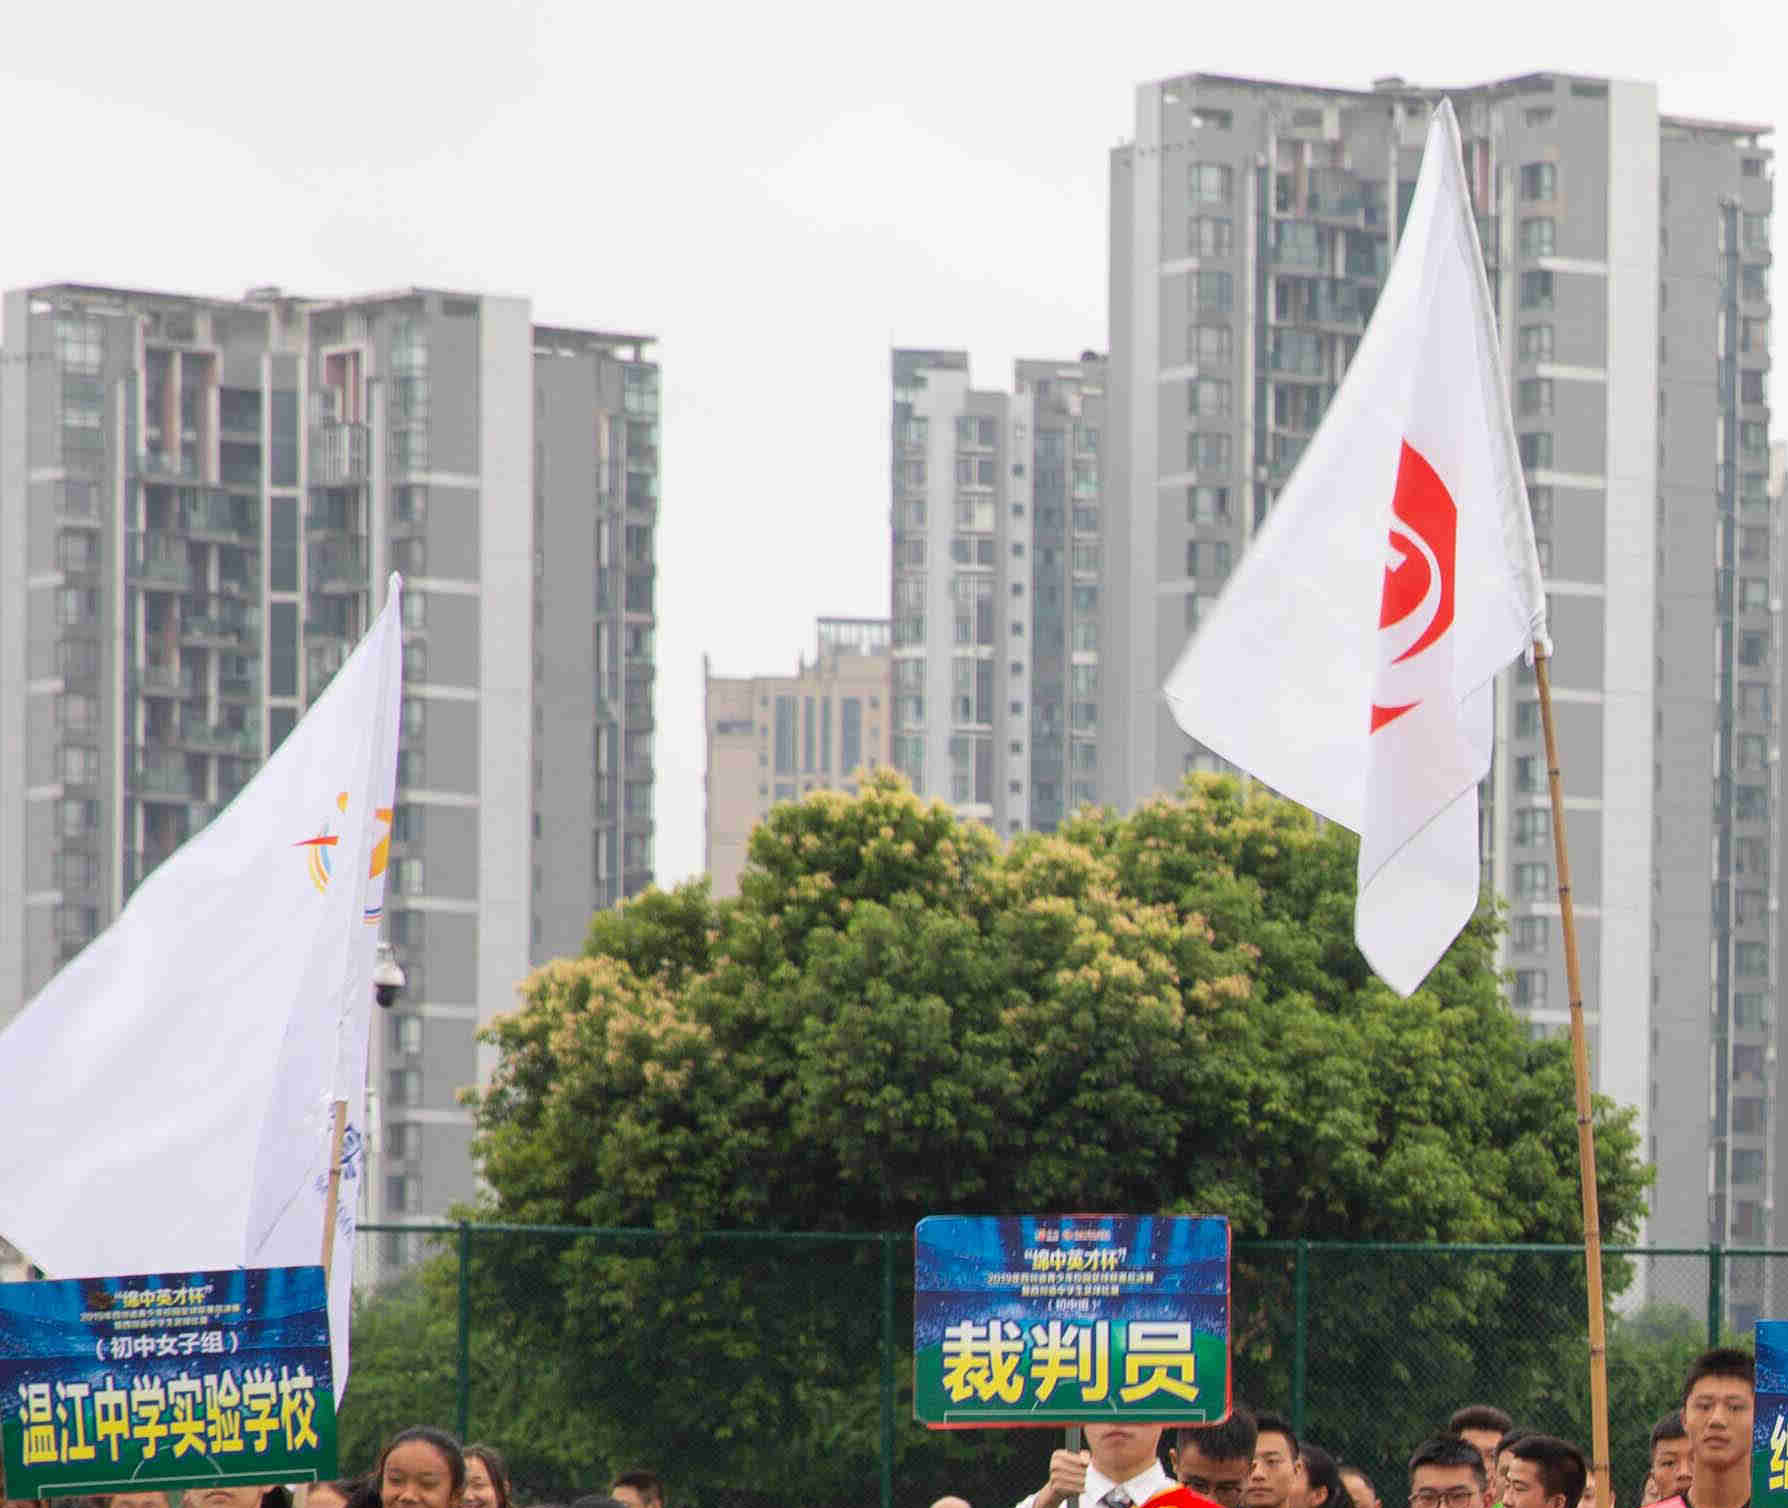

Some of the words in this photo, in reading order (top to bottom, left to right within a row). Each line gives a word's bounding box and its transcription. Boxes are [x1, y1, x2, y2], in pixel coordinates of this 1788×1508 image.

[943, 1320, 1200, 1403] 裁判员
[18, 1365, 318, 1466] 温江中学实验学校
